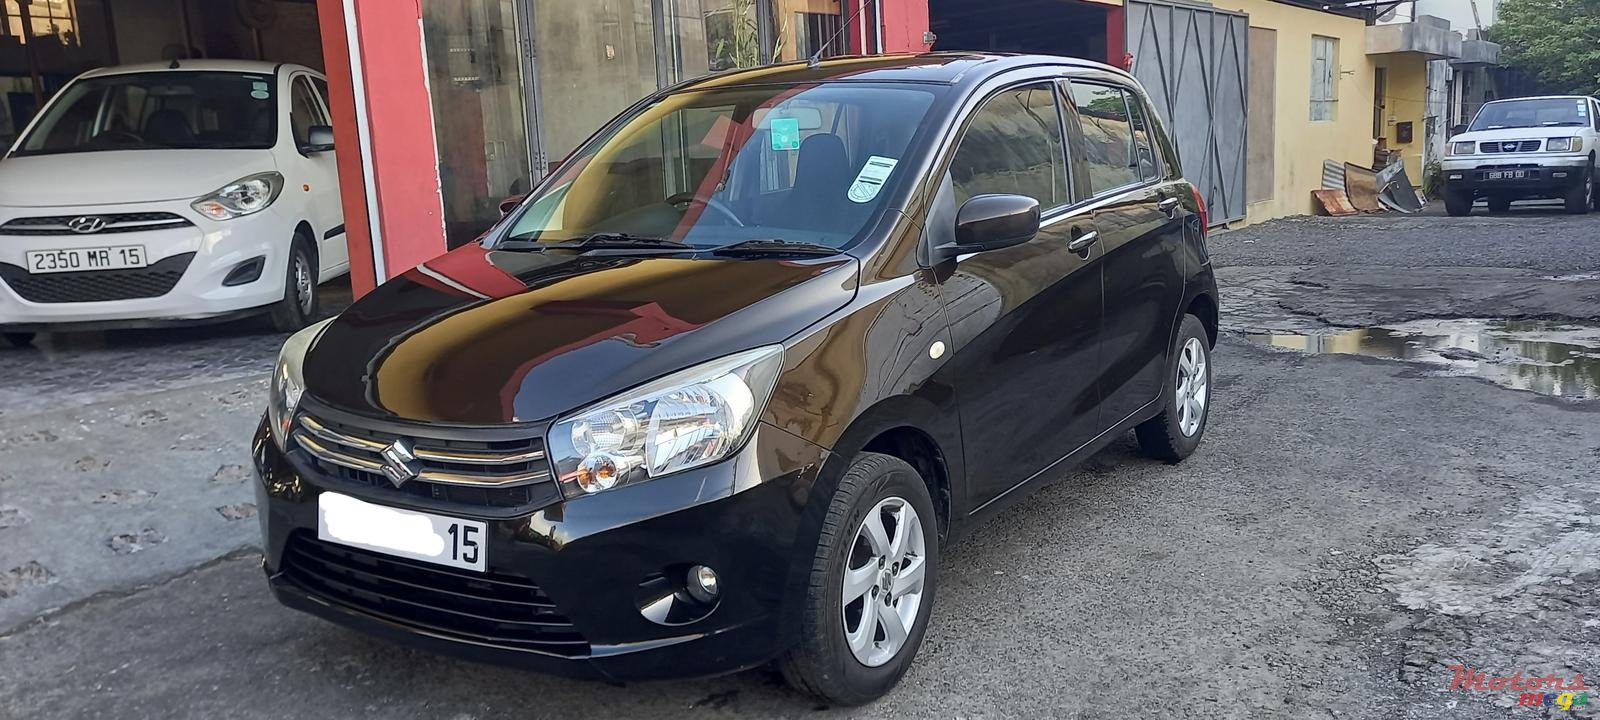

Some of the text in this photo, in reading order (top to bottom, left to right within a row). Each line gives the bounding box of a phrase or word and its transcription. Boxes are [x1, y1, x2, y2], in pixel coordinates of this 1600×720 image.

[34, 248, 140, 270] 2350 MR 15
[448, 523, 479, 564] 15
